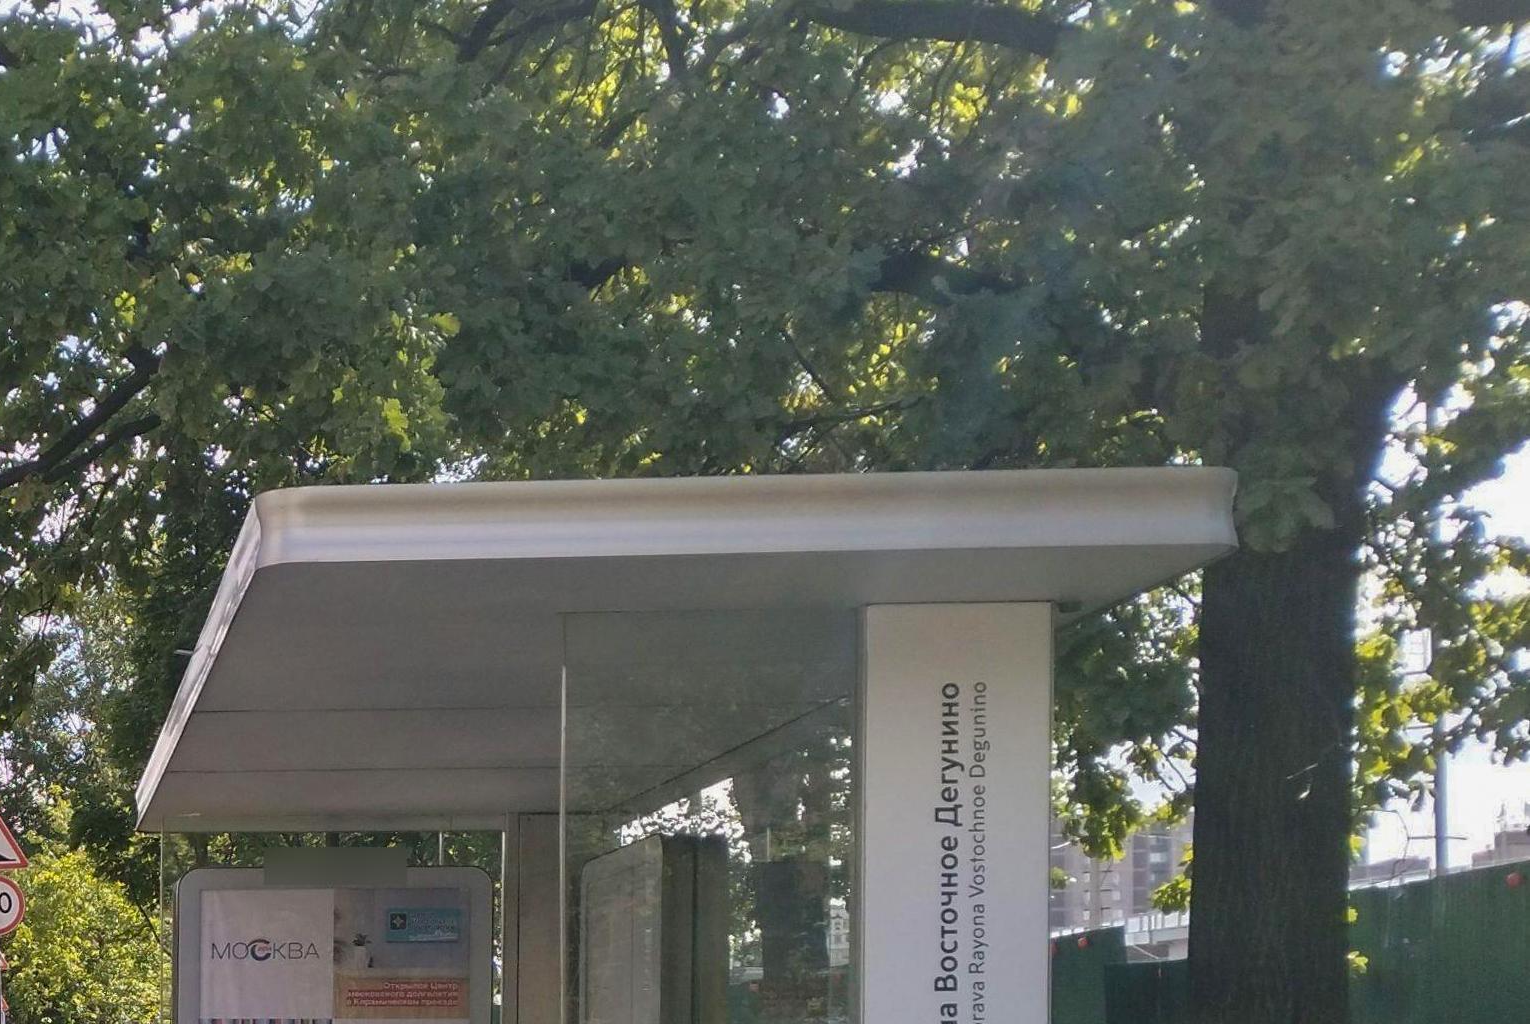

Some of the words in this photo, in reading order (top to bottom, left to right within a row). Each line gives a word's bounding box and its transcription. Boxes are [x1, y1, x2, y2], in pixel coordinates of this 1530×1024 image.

[934, 682, 965, 827] Дегунино
[969, 681, 991, 778] Degunino
[968, 784, 986, 898] Vostochnoe
[211, 939, 320, 961] МОСКВА
[933, 835, 959, 992] Восточное
[968, 903, 989, 974] Rayona
